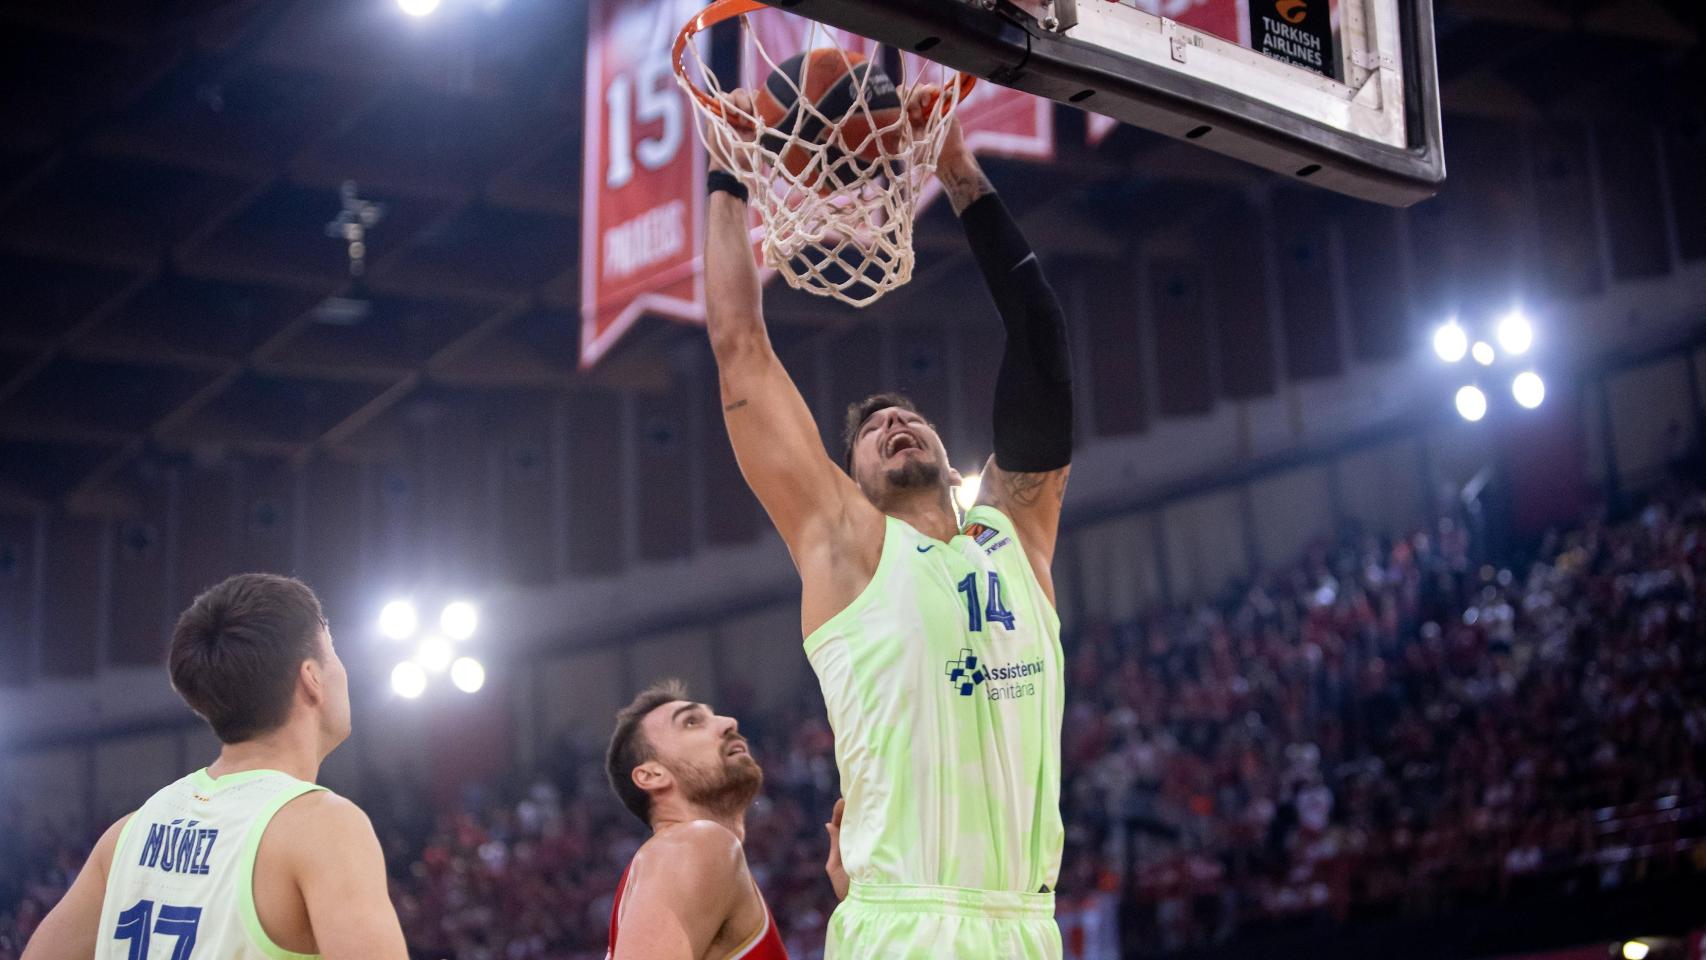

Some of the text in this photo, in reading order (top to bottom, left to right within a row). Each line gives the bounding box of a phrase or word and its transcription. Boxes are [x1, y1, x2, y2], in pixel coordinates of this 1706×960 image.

[1262, 16, 1320, 50] TURKISH
[1263, 33, 1322, 66] AIRLINES
[606, 63, 684, 188] 15
[957, 571, 1016, 632] 14
[138, 819, 219, 875] NÚÑEZ
[113, 899, 203, 960] 17
